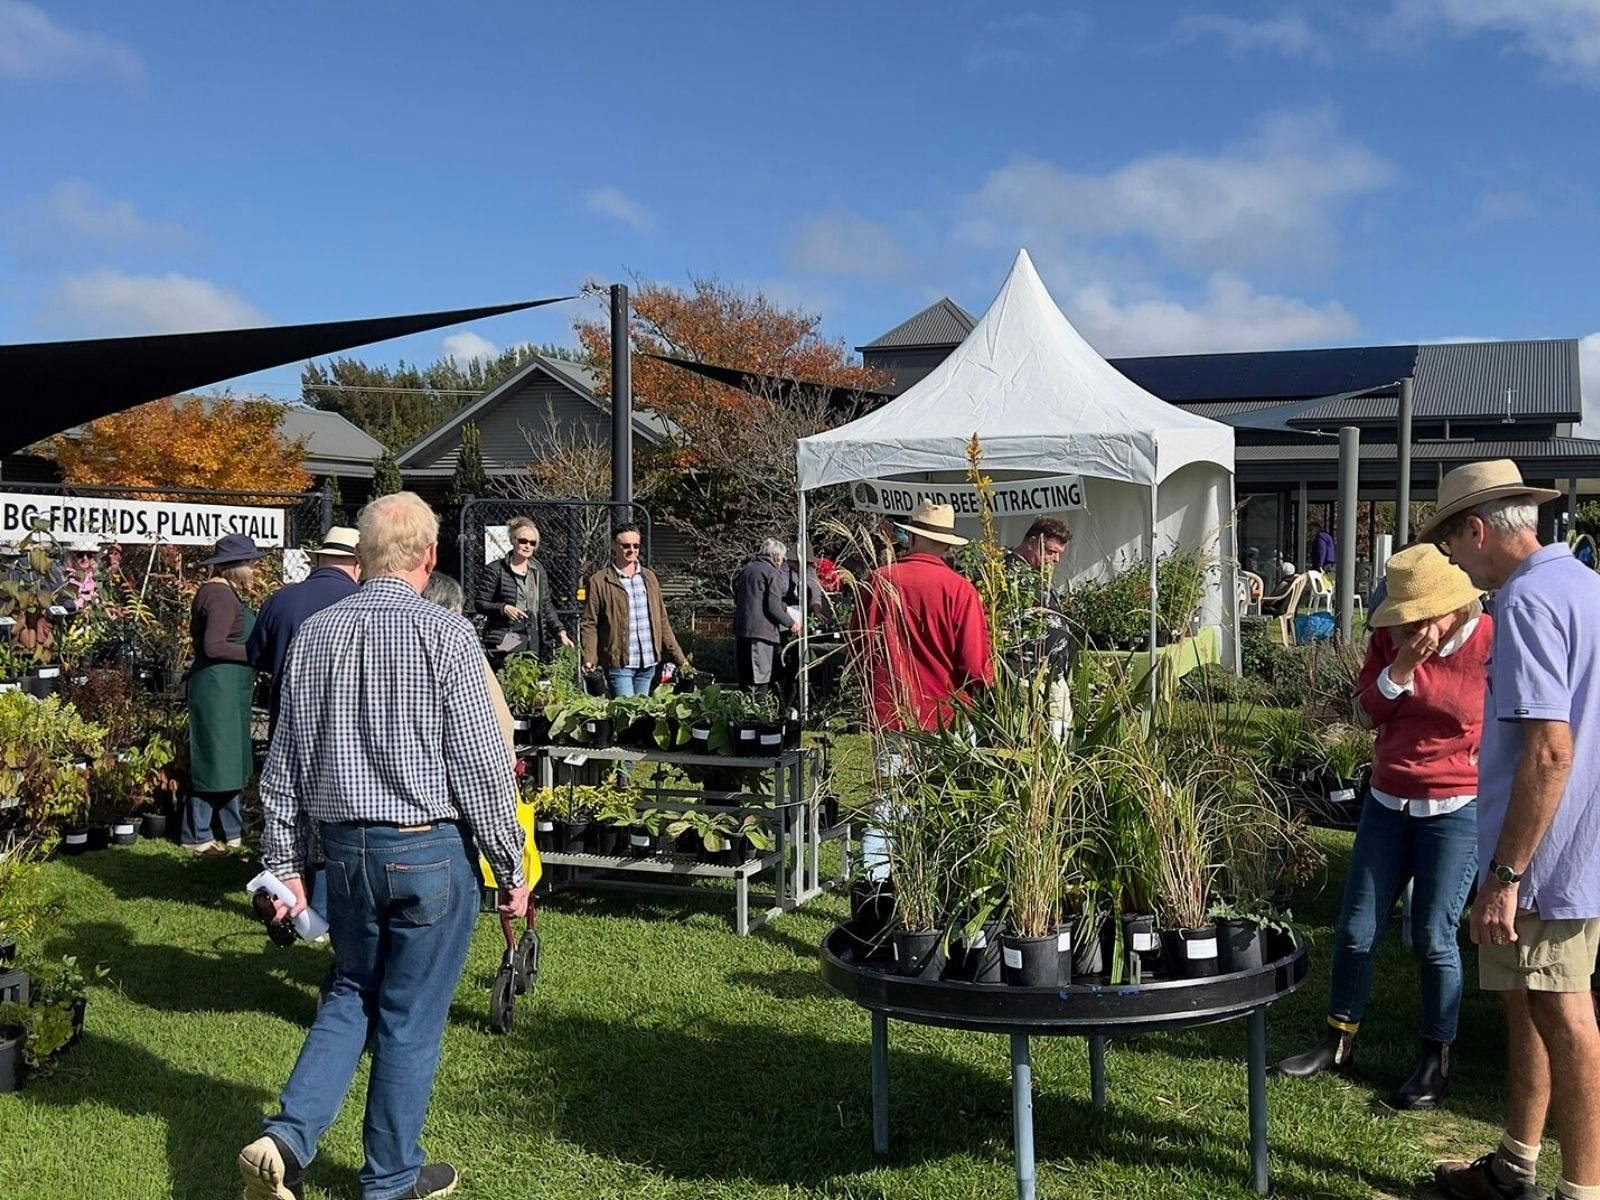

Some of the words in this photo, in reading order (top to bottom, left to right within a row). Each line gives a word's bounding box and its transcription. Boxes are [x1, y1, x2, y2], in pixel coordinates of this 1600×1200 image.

[881, 488, 914, 512] BIRD
[949, 492, 979, 513] BEE
[50, 505, 149, 535] FRIENDS
[157, 511, 222, 537] PLANT
[229, 514, 278, 539] STALL
